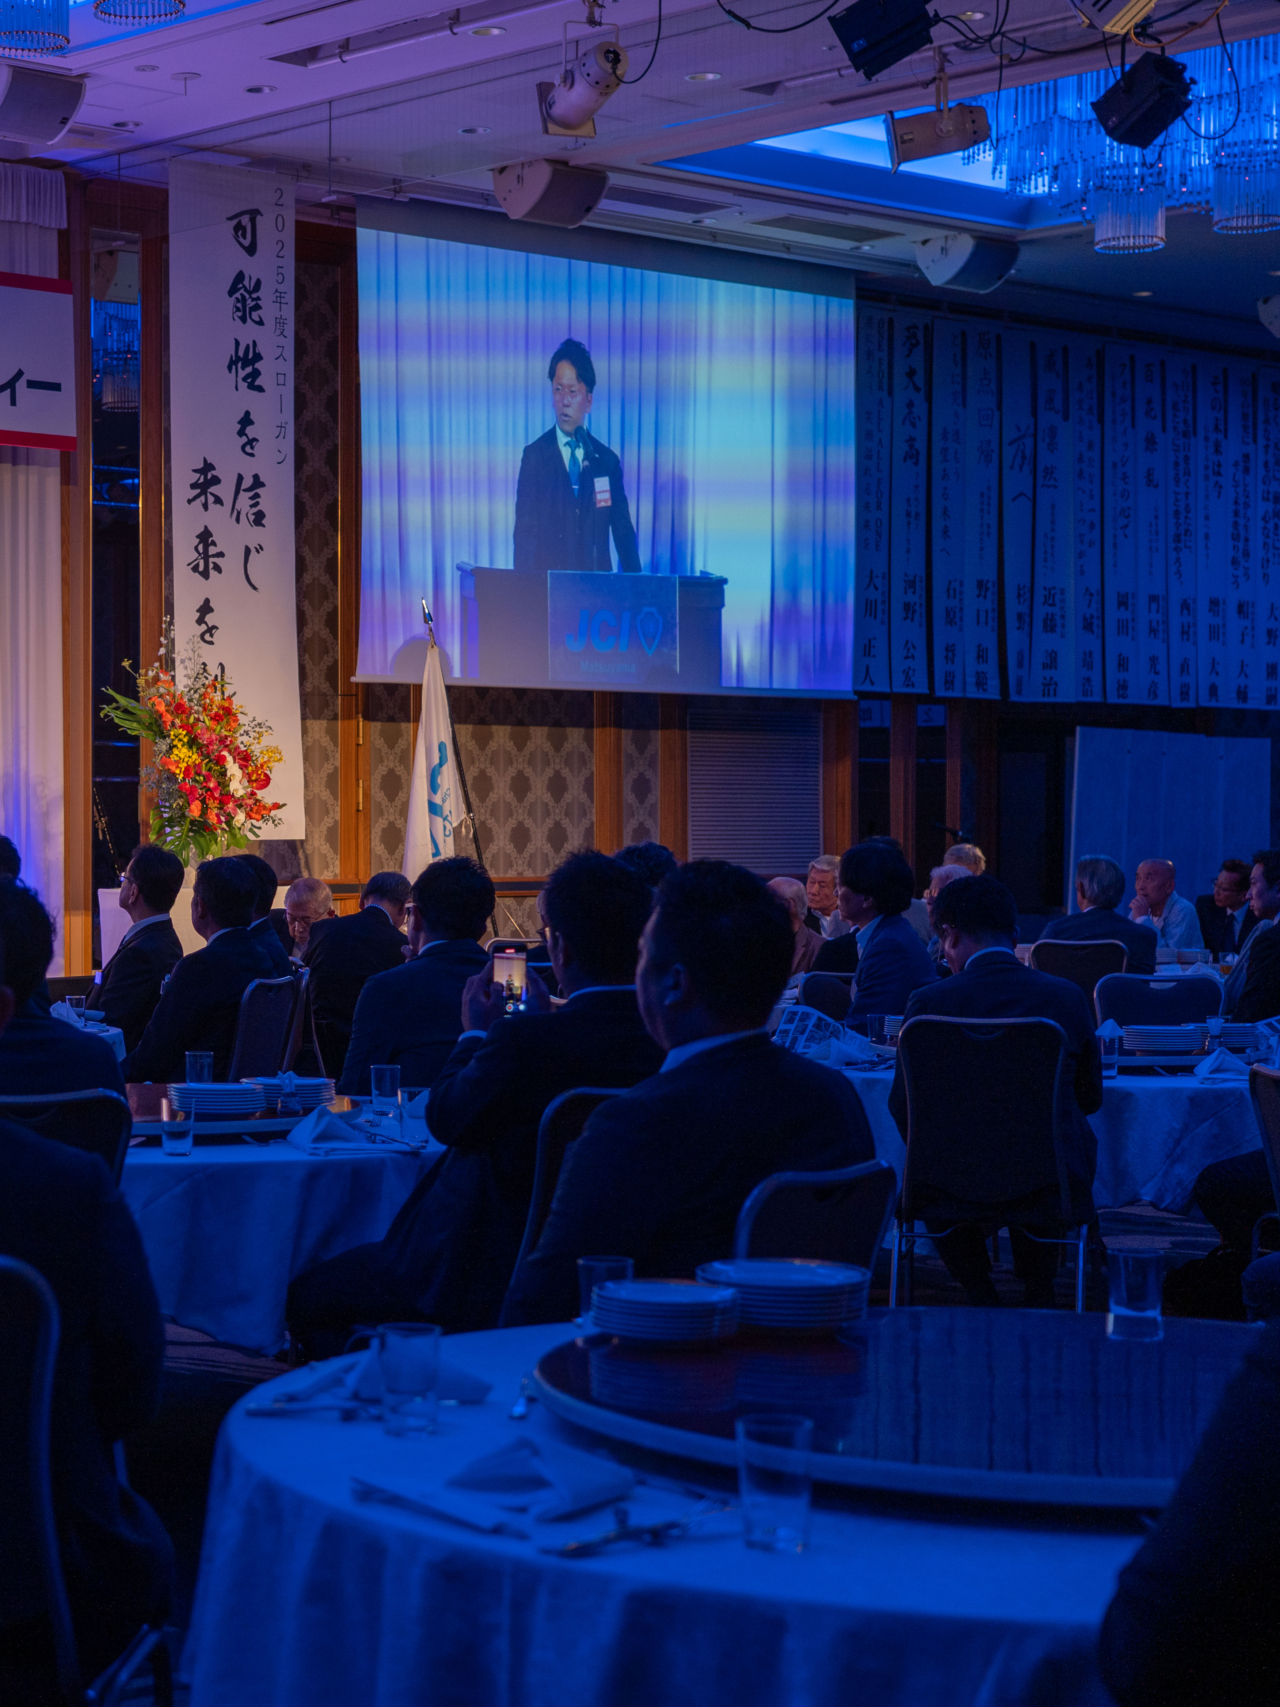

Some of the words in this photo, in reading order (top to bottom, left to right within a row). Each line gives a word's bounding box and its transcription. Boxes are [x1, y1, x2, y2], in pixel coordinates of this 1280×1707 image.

[225, 207, 268, 594] 可能性を信じ
[271, 187, 290, 466] 2025年度スローガン
[976, 330, 995, 469] 原点回帰
[565, 608, 631, 653] JCI
